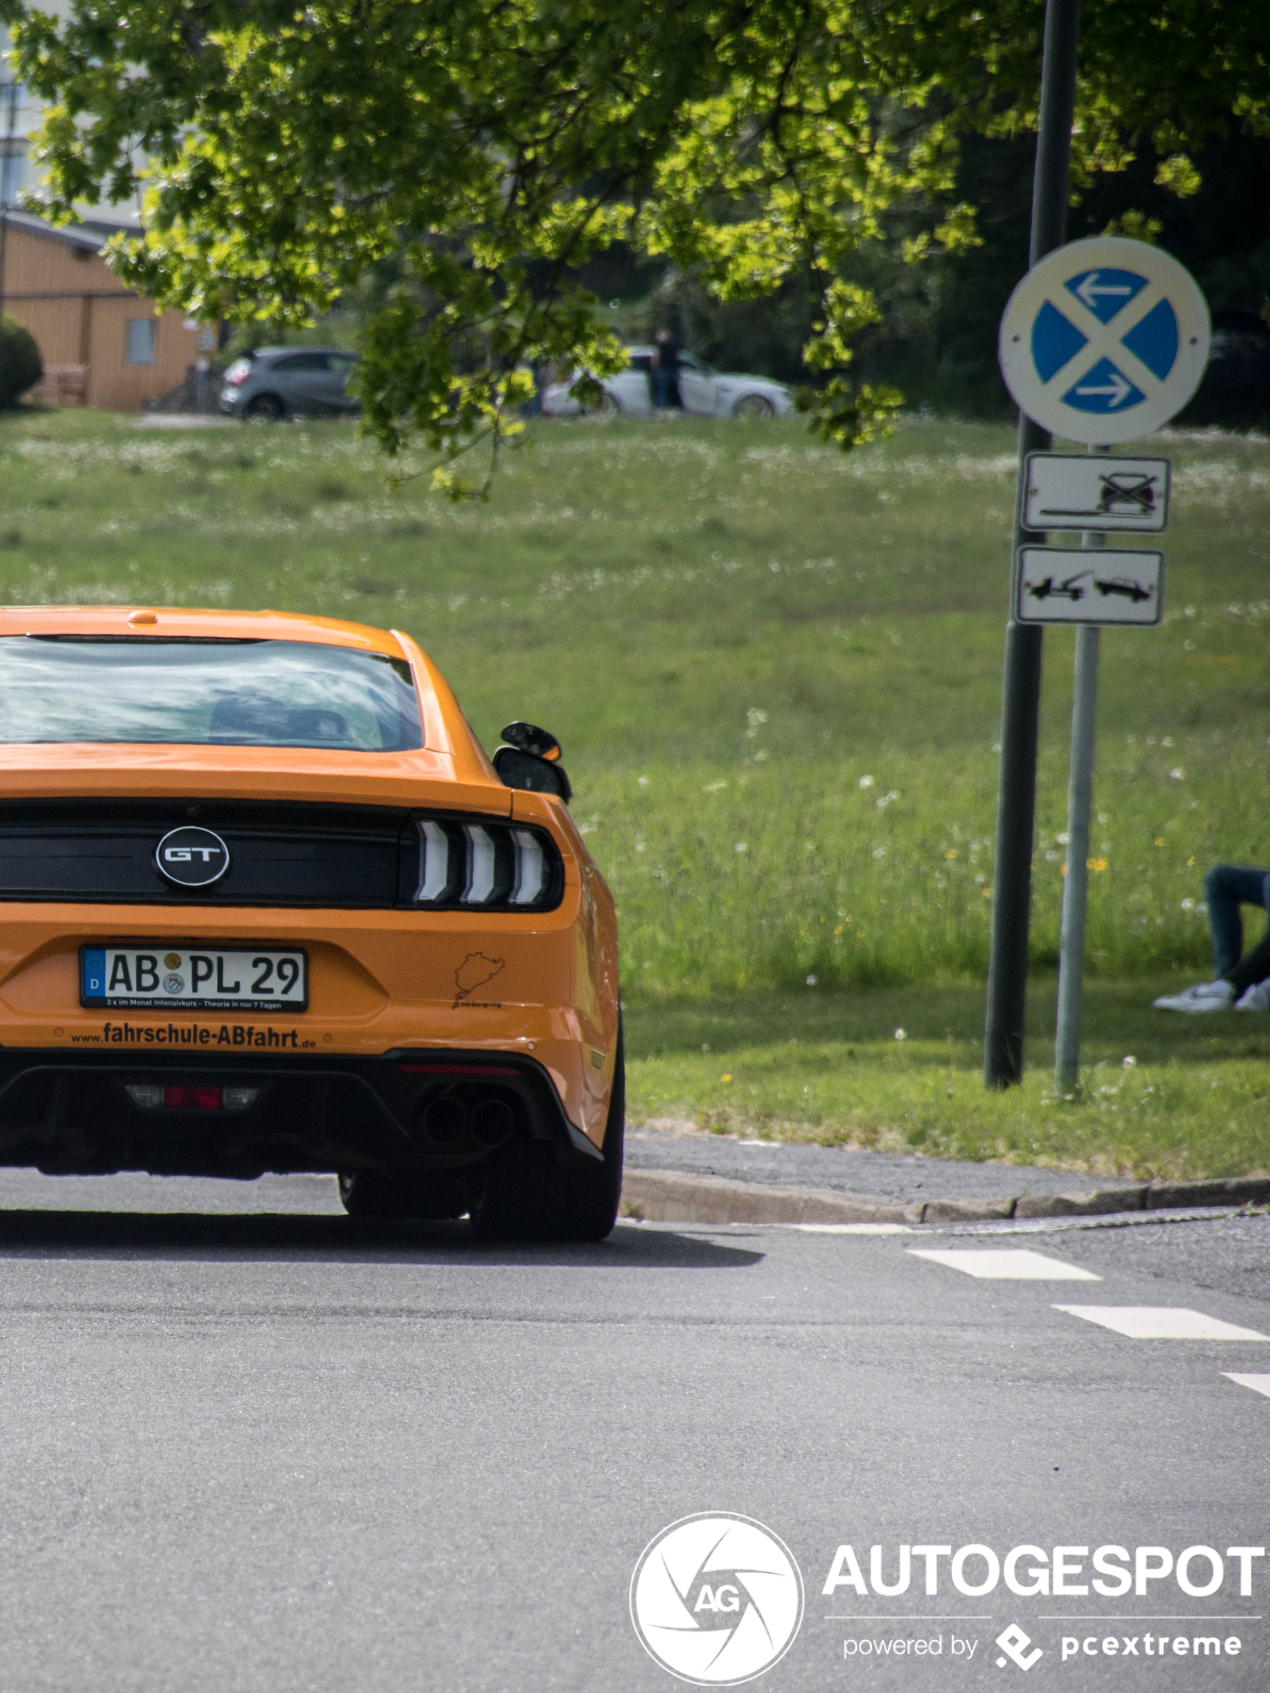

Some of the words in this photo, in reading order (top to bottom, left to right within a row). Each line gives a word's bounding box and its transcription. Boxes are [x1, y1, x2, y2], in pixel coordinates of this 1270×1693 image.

[164, 847, 221, 862] GT
[108, 954, 160, 992] AB
[189, 955, 241, 993] PL
[251, 957, 300, 995] 29
[90, 979, 99, 989] D
[153, 999, 197, 1007] Intensivkurs
[260, 1002, 282, 1010] Tagen
[71, 1023, 316, 1048] www.fahrschule-ABfahrt.de
